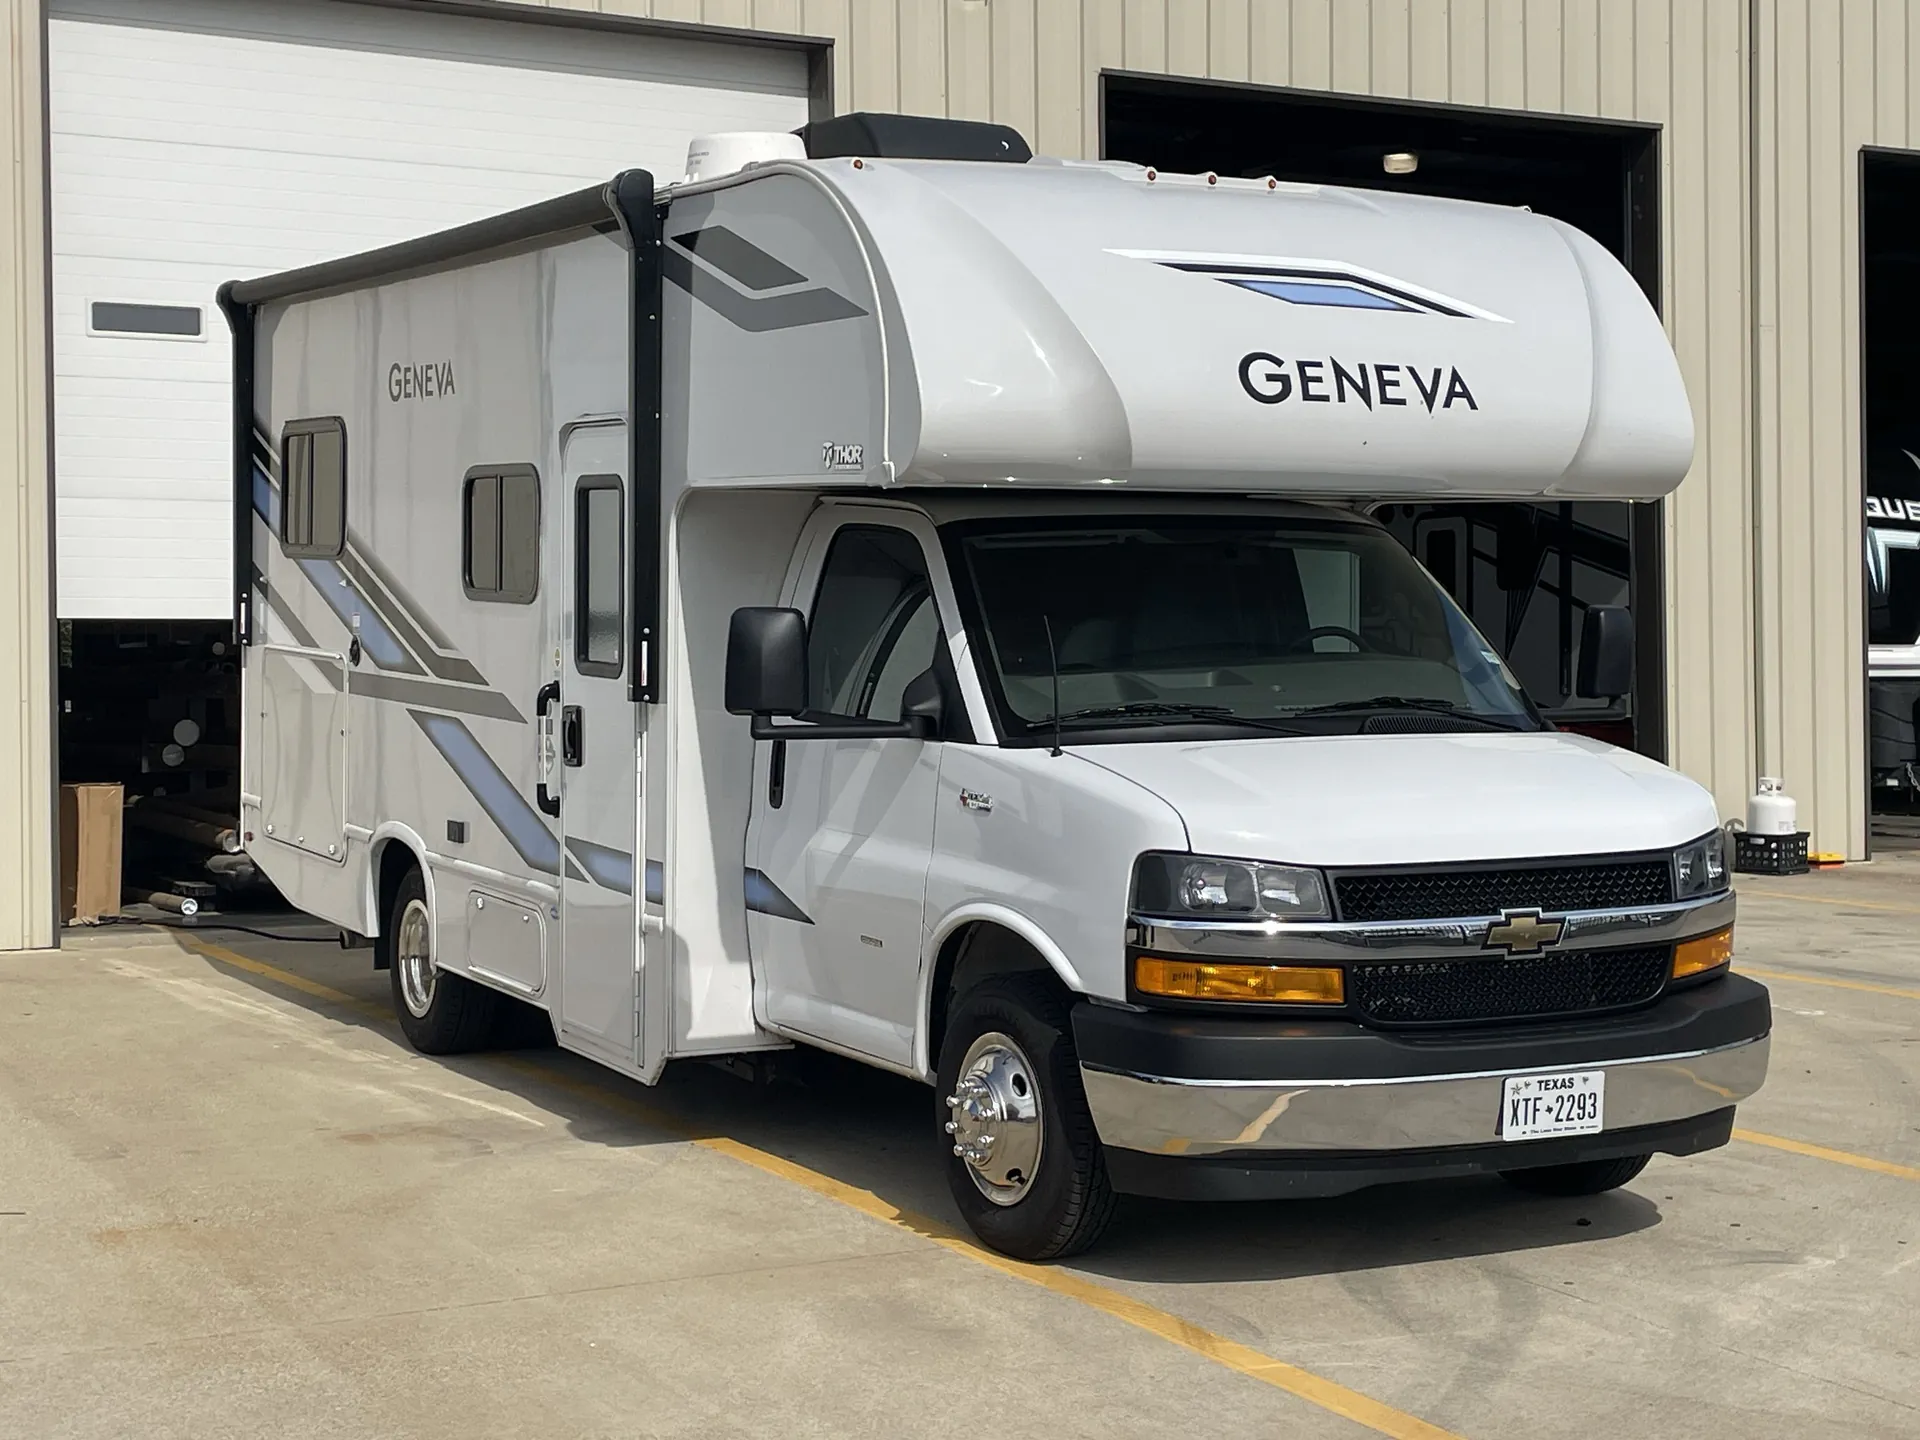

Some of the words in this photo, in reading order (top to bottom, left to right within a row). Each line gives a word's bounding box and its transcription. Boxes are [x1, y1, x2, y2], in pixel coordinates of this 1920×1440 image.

[388, 359, 455, 402] GENEVA
[1238, 351, 1479, 414] GENEVA
[834, 445, 863, 464] THOR
[1537, 1077, 1575, 1092] TEXAS
[1510, 1097, 1543, 1127] XTF
[1554, 1092, 1597, 1123] 2293
